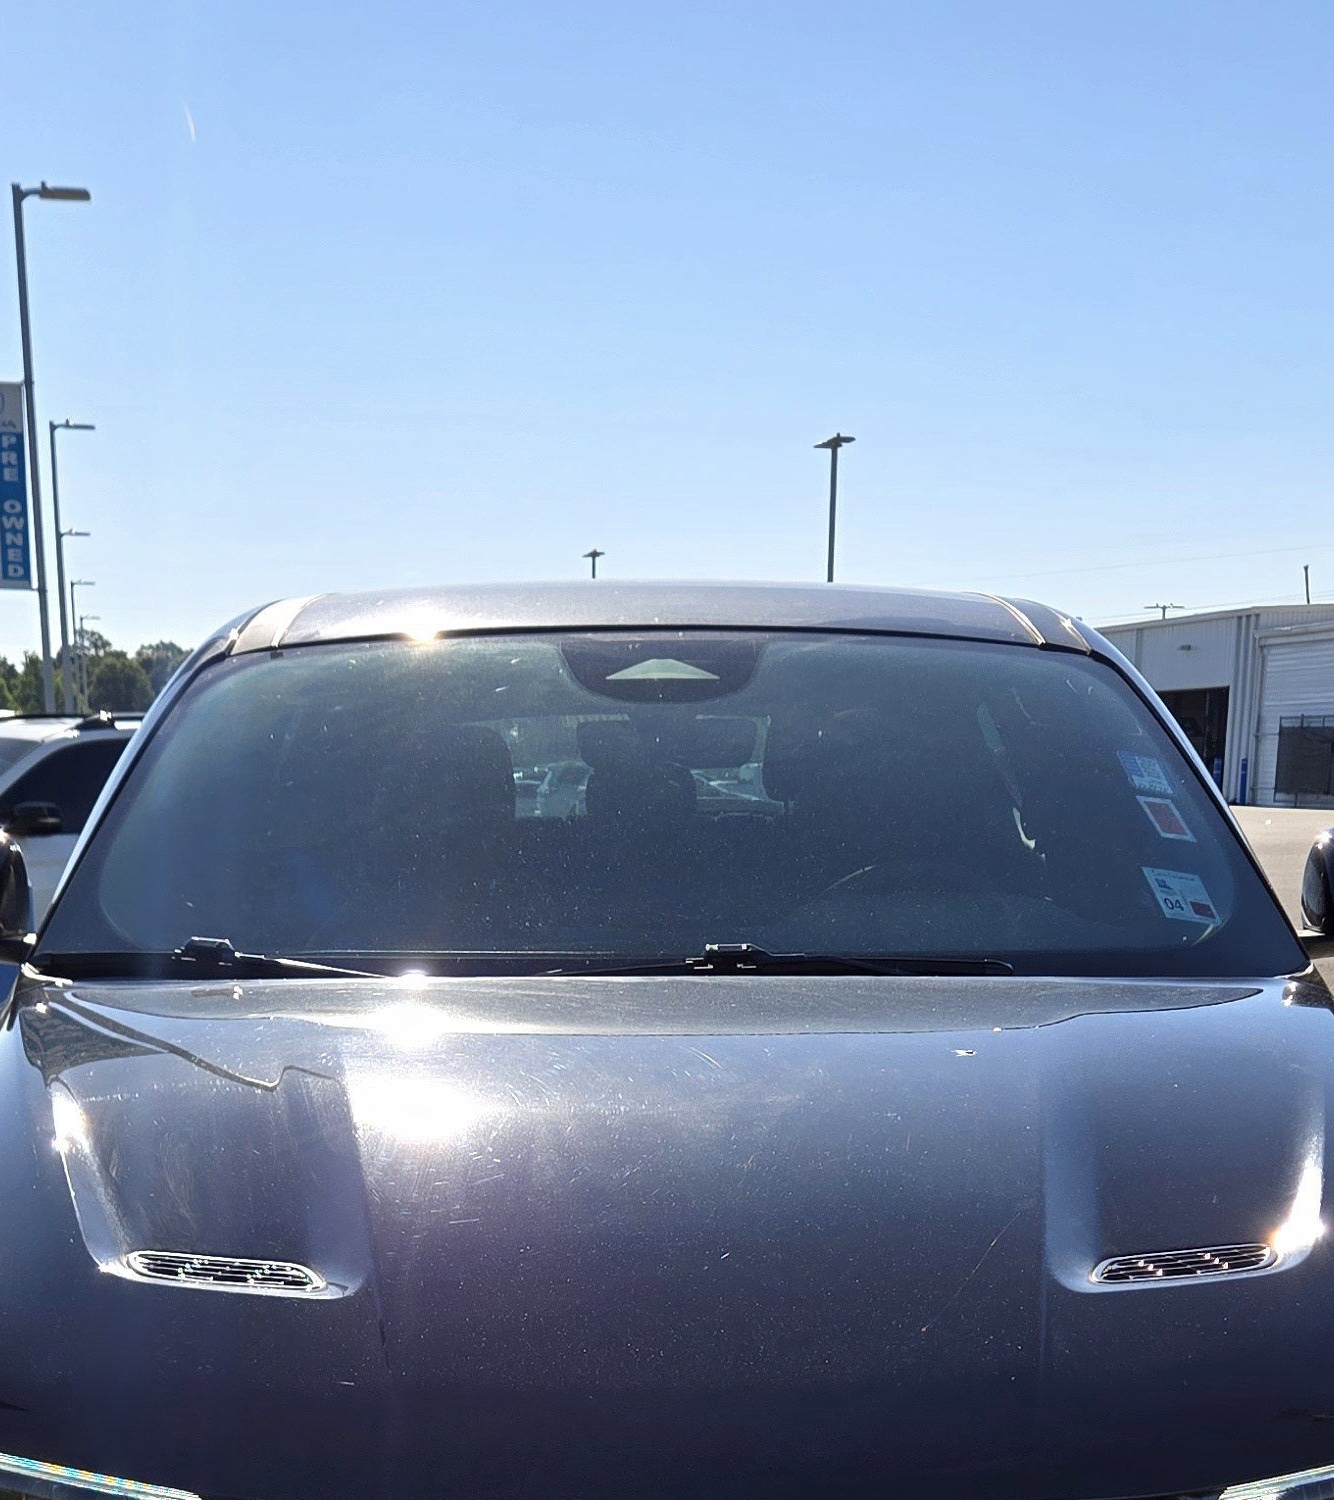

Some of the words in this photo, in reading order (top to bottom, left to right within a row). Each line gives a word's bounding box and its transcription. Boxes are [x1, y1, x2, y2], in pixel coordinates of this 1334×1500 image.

[0, 434, 19, 482] PRE
[2, 499, 25, 578] OWNED
[1164, 897, 1184, 911] 04
